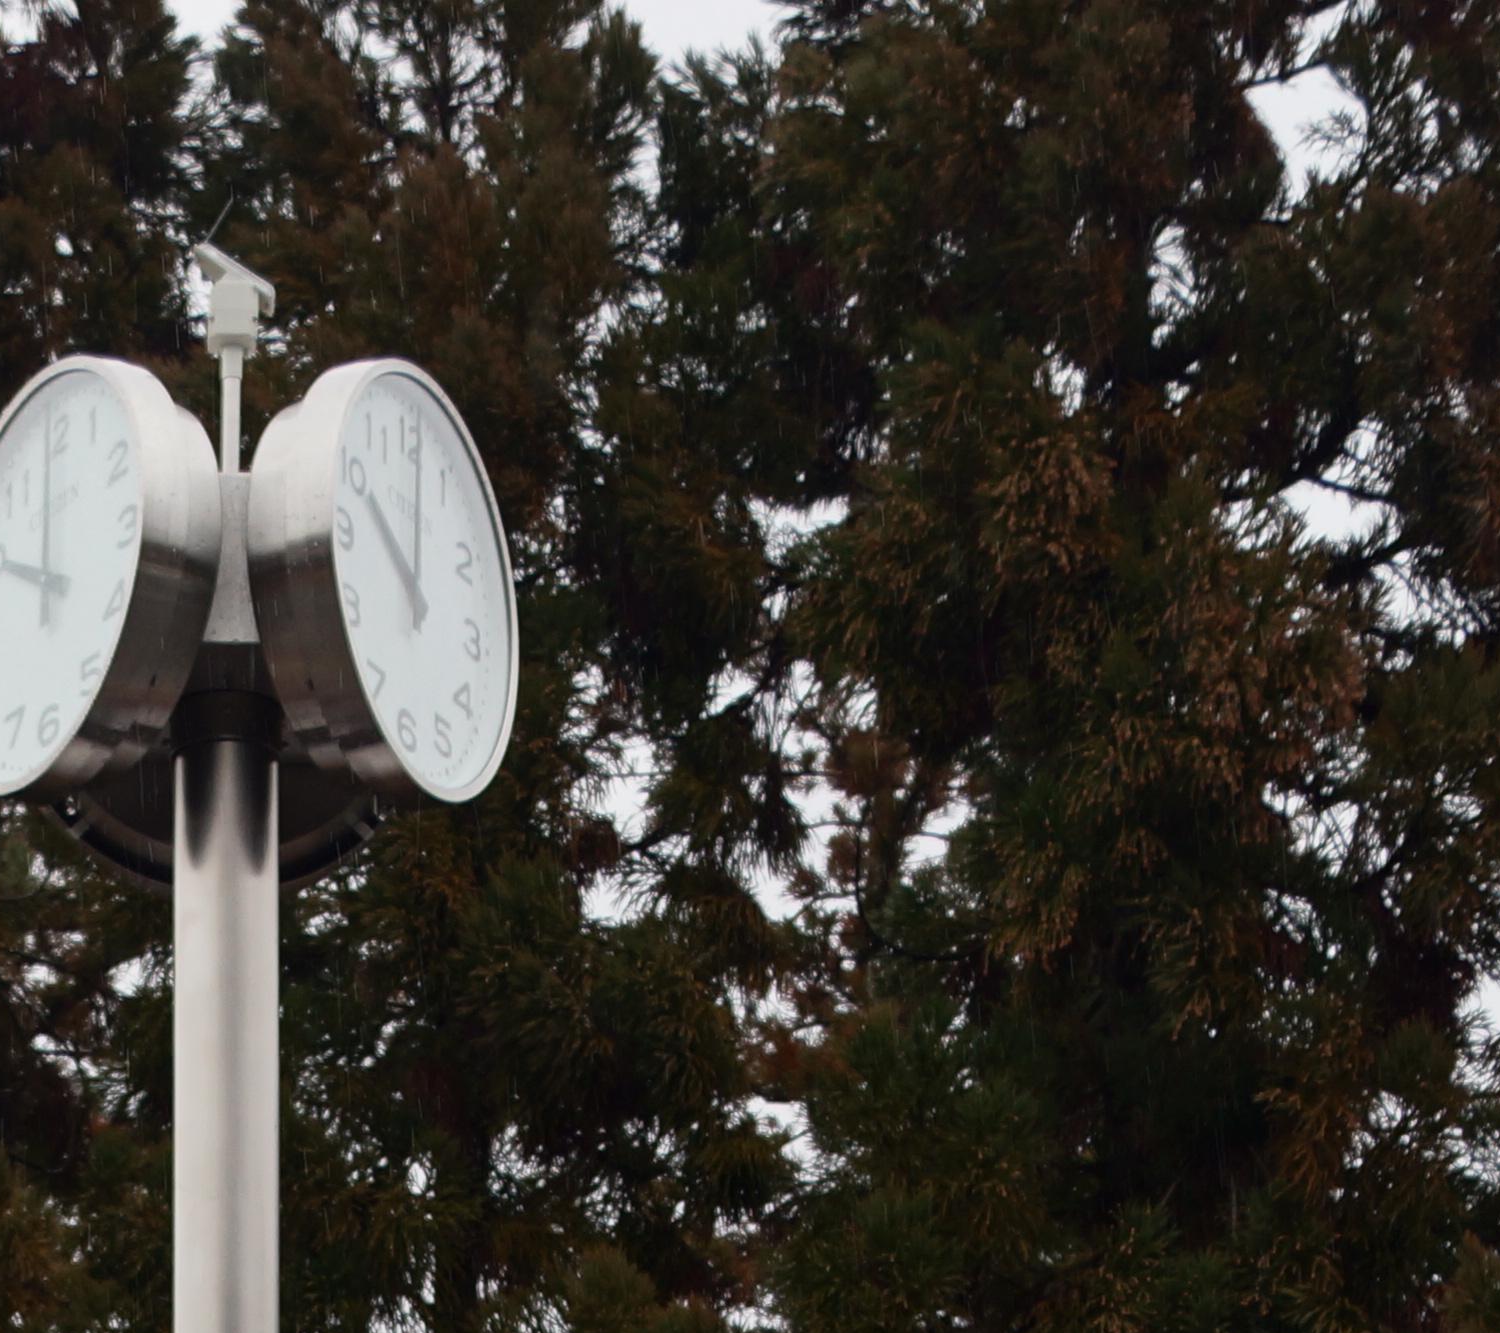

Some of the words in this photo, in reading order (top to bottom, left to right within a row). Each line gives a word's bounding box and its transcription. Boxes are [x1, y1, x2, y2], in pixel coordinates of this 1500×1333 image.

[106, 438, 129, 487] 2
[339, 444, 368, 498] 10
[117, 503, 138, 549] 3
[456, 540, 474, 586] 2
[463, 616, 482, 663] 3
[4, 703, 27, 750] 7
[37, 703, 61, 748] 6
[397, 707, 418, 754] 6
[434, 710, 452, 759] 5
